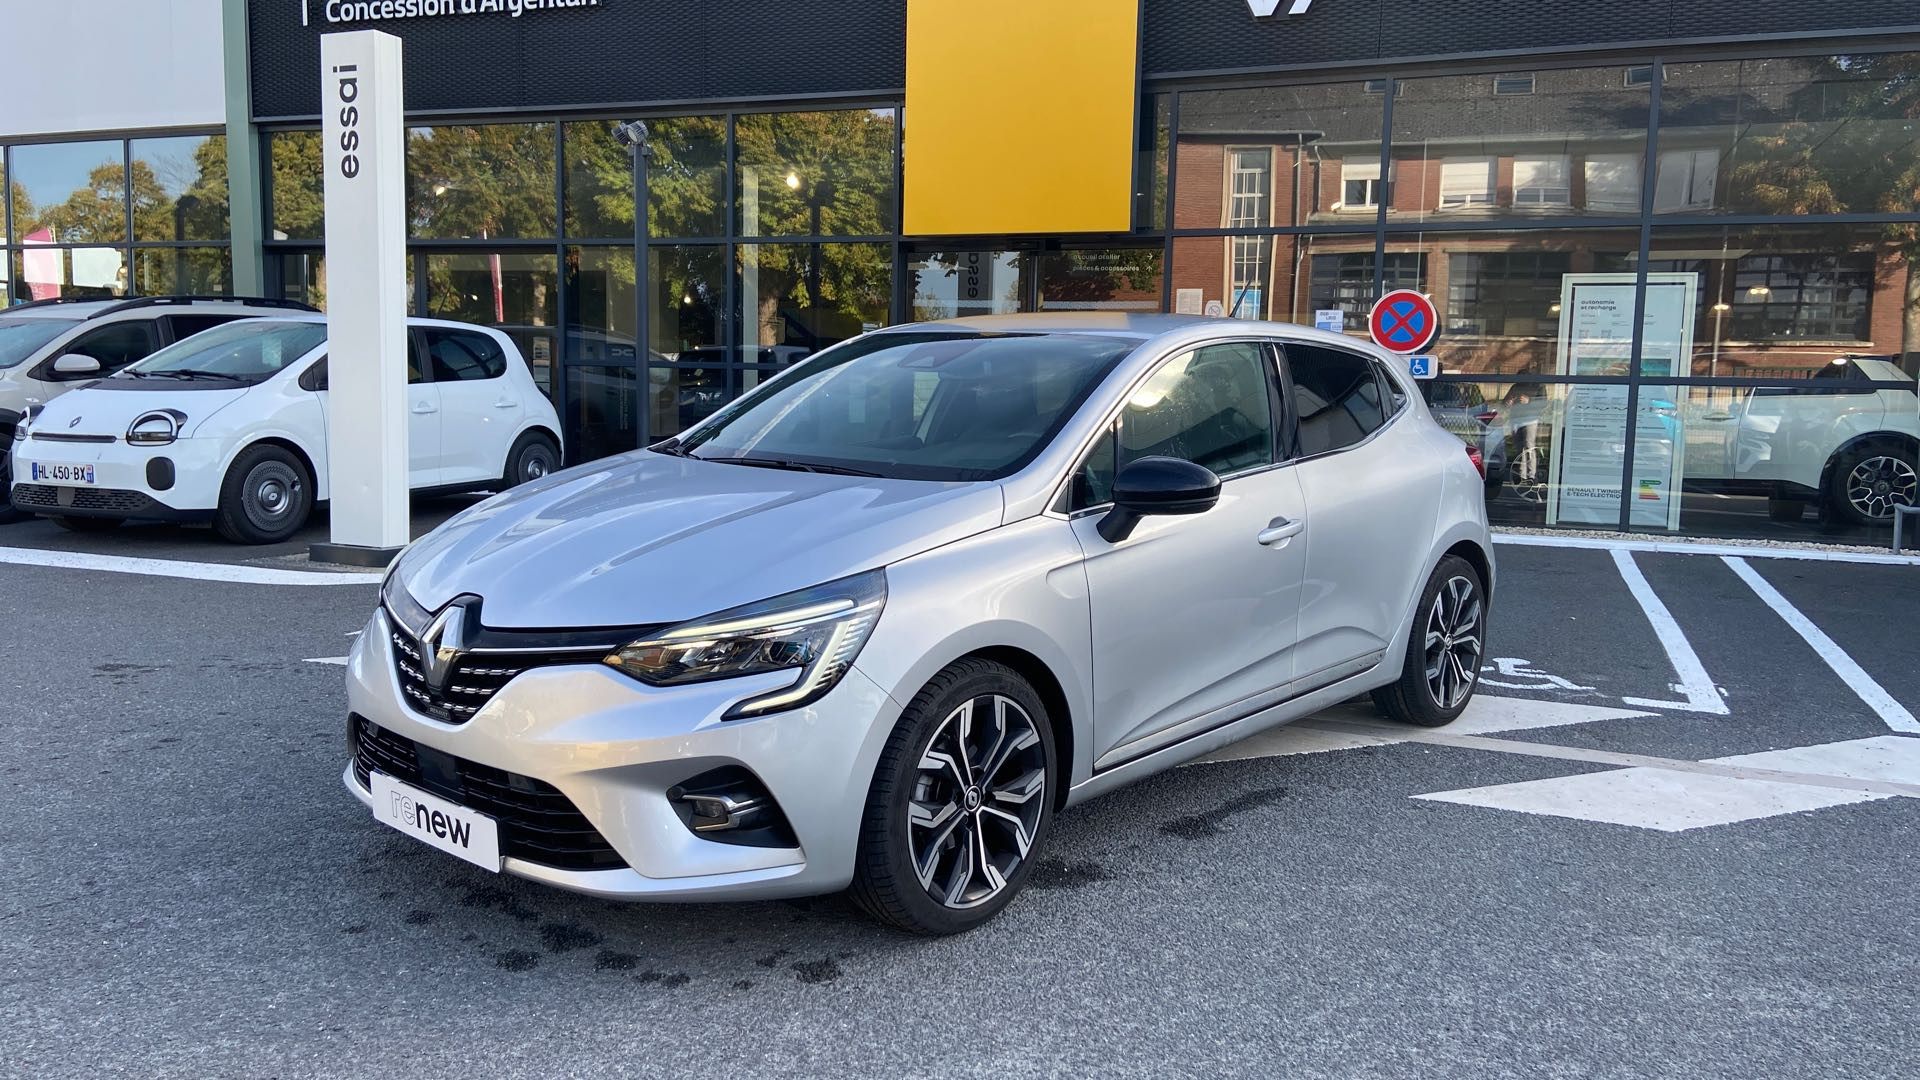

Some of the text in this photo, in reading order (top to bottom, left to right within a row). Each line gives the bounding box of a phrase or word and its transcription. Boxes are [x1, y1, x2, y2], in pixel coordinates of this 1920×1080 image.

[325, 0, 598, 22] Concession dArgen
[332, 65, 360, 179] essai
[391, 790, 471, 849] renew
